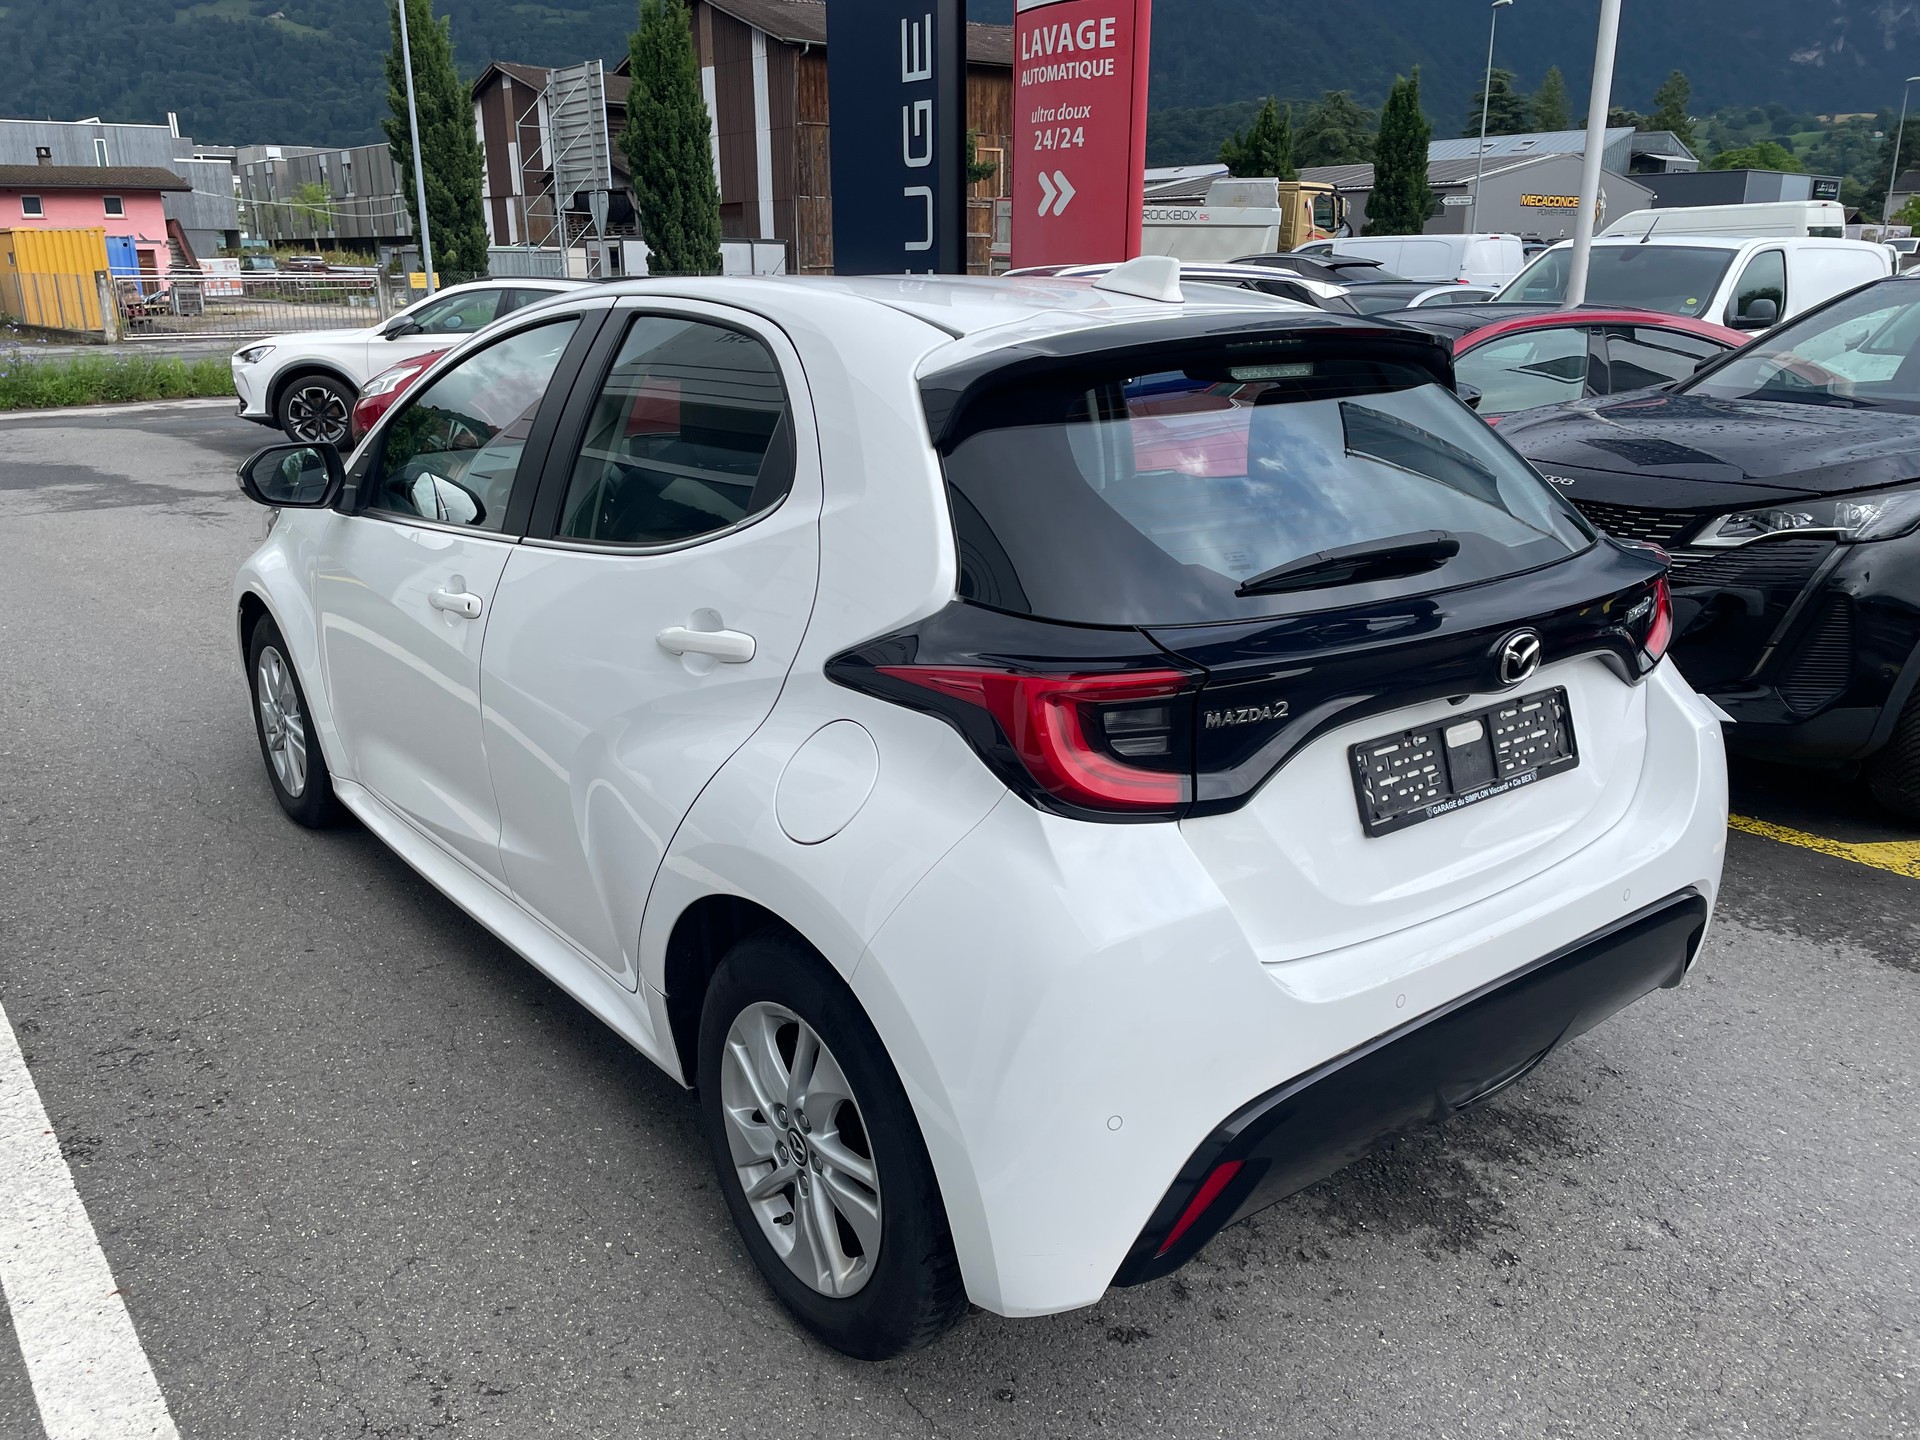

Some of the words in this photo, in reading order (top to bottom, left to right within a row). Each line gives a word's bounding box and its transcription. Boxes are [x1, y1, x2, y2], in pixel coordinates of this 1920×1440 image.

[1022, 17, 1116, 60] LAVAGE
[1021, 58, 1114, 87] AUTOMATIQUE
[1031, 106, 1055, 124] ultra
[1057, 102, 1092, 121] doux
[901, 14, 933, 275] UGE
[1034, 126, 1085, 151] 24/24
[1142, 209, 1197, 221] ROCKBOX
[1432, 800, 1457, 815] GARAGE
[1457, 798, 1465, 806] du
[1464, 789, 1489, 804] SIMPLON
[1488, 782, 1509, 796] Viscardi
[1520, 774, 1533, 784] BEX
